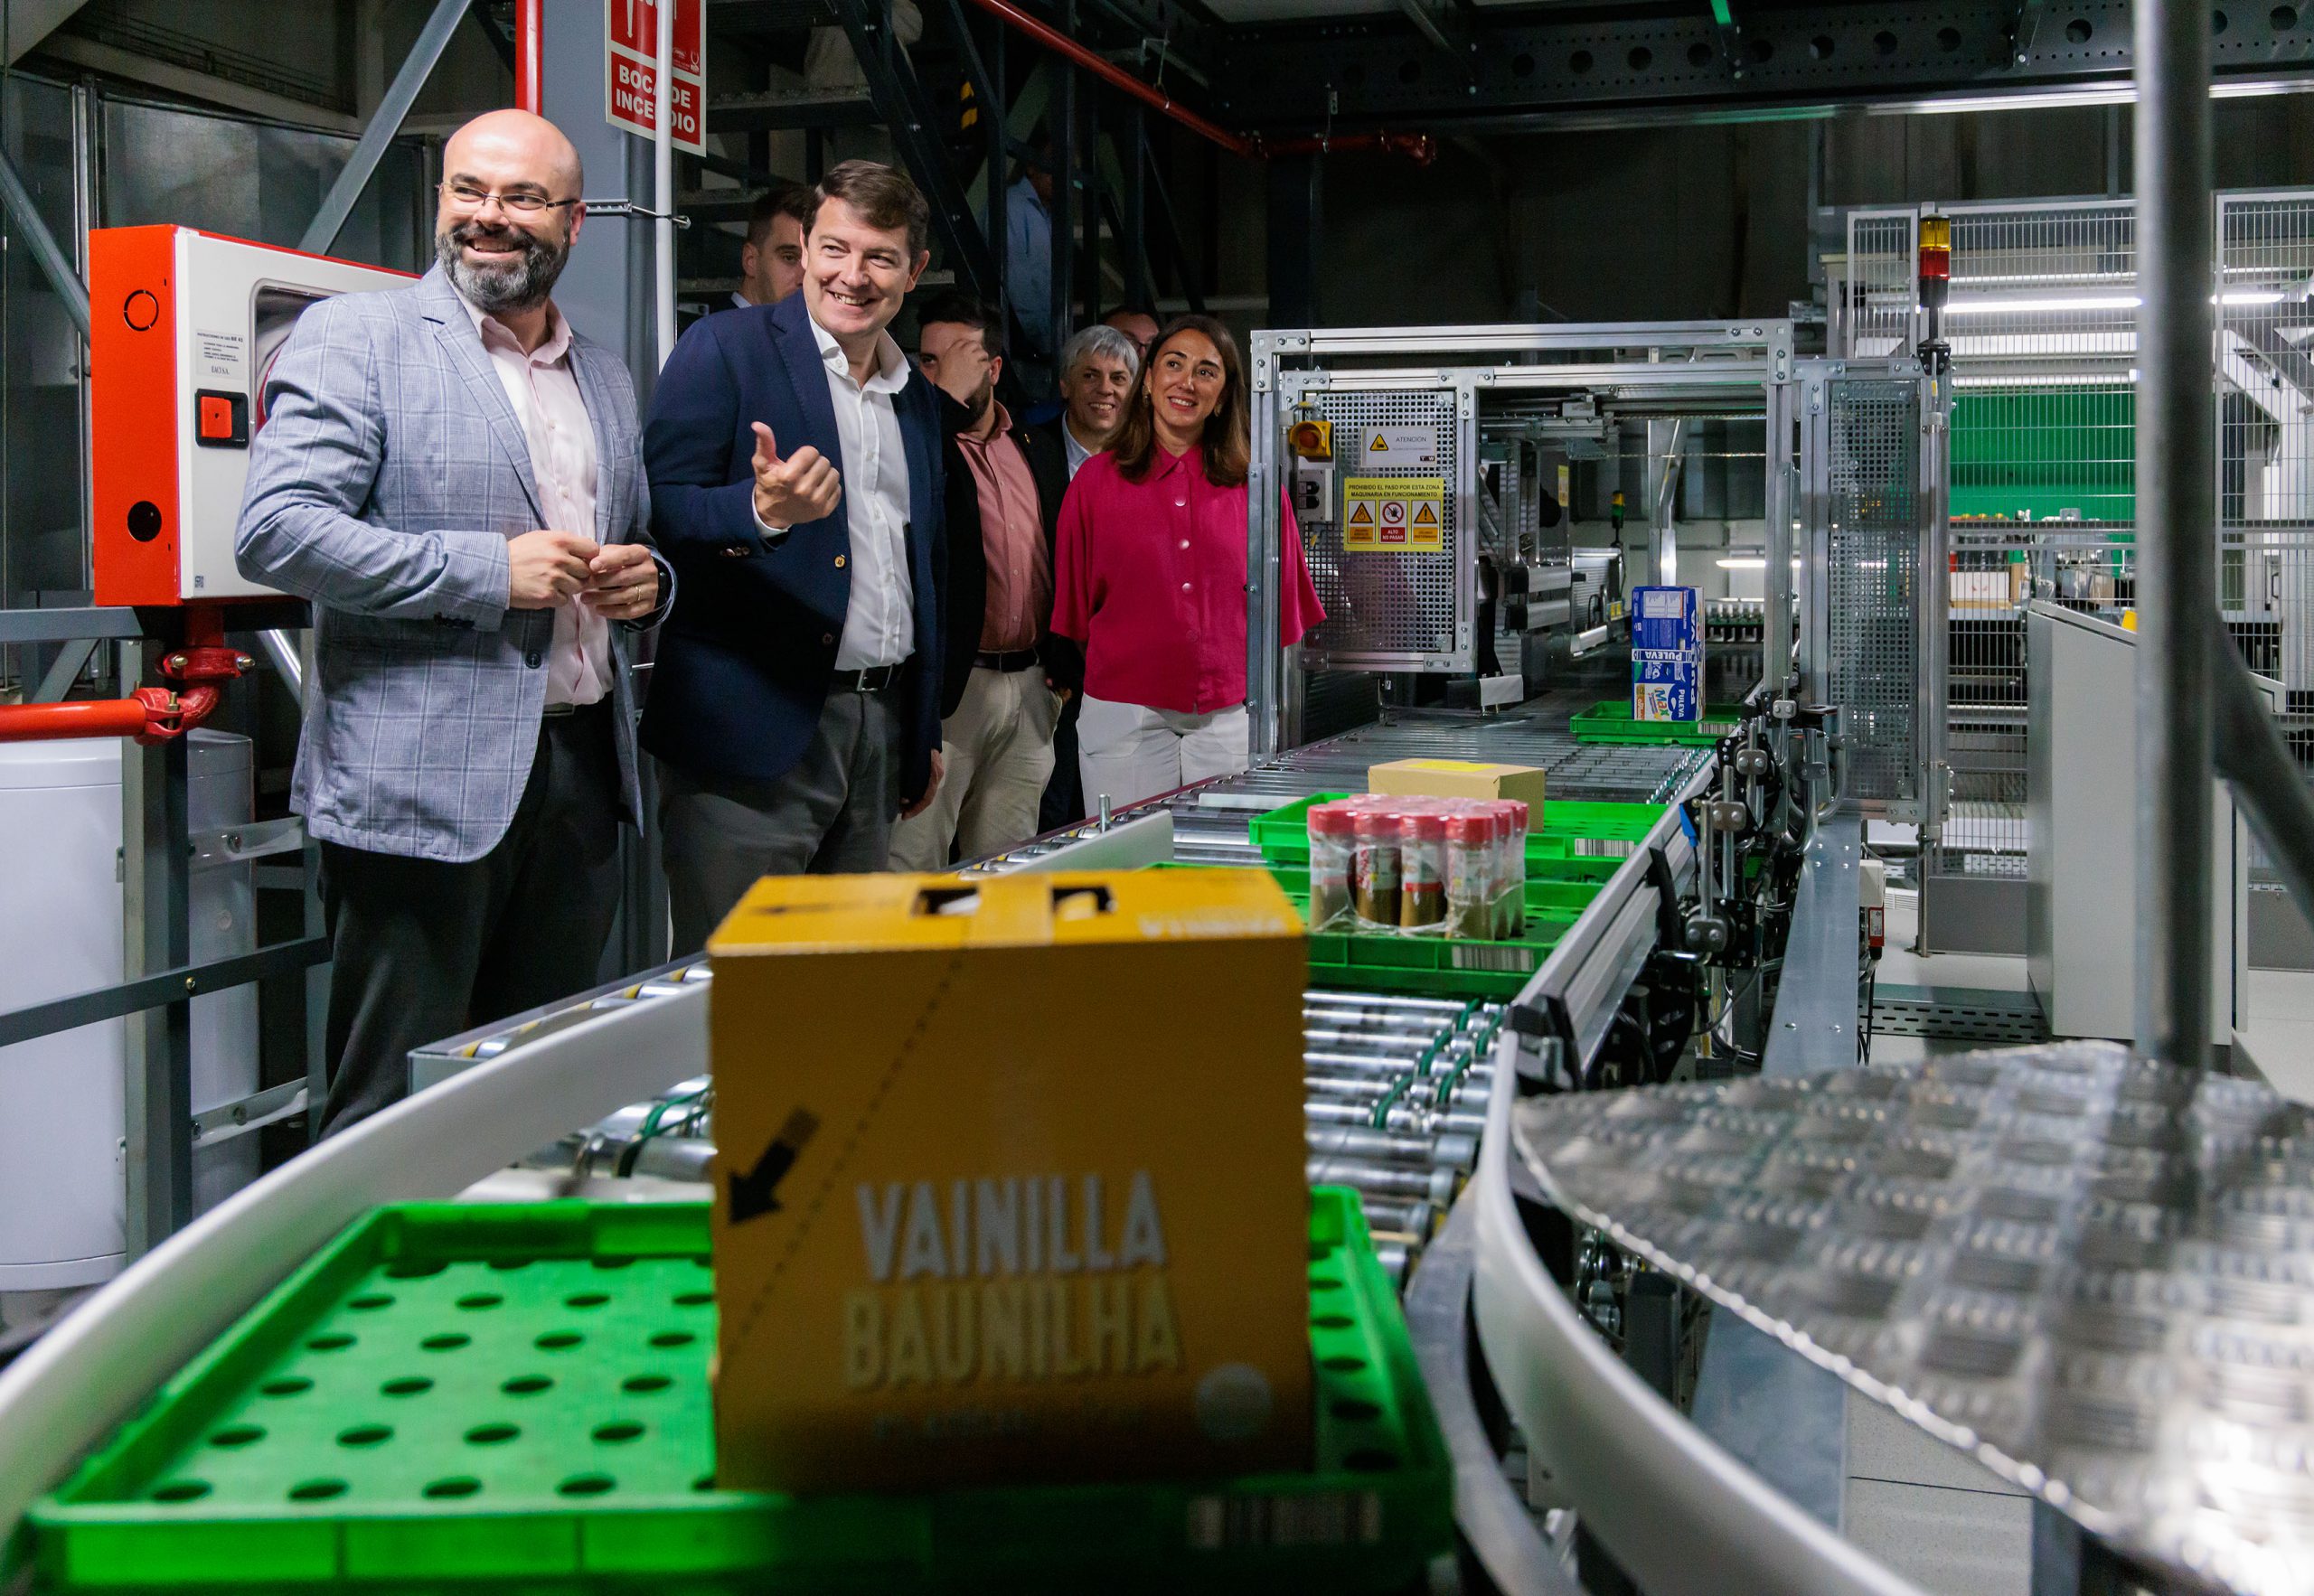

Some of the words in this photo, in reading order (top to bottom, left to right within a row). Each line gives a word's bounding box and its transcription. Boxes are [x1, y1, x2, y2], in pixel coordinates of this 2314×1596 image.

[619, 64, 657, 97] BOC
[616, 88, 695, 134] INCEDIO
[1644, 651, 1683, 662] PULEVA
[1654, 689, 1670, 717] Max
[1678, 689, 1686, 718] PULEVA
[855, 1169, 1168, 1281] VAINILLA
[843, 1272, 1181, 1389] BAUNILHA
